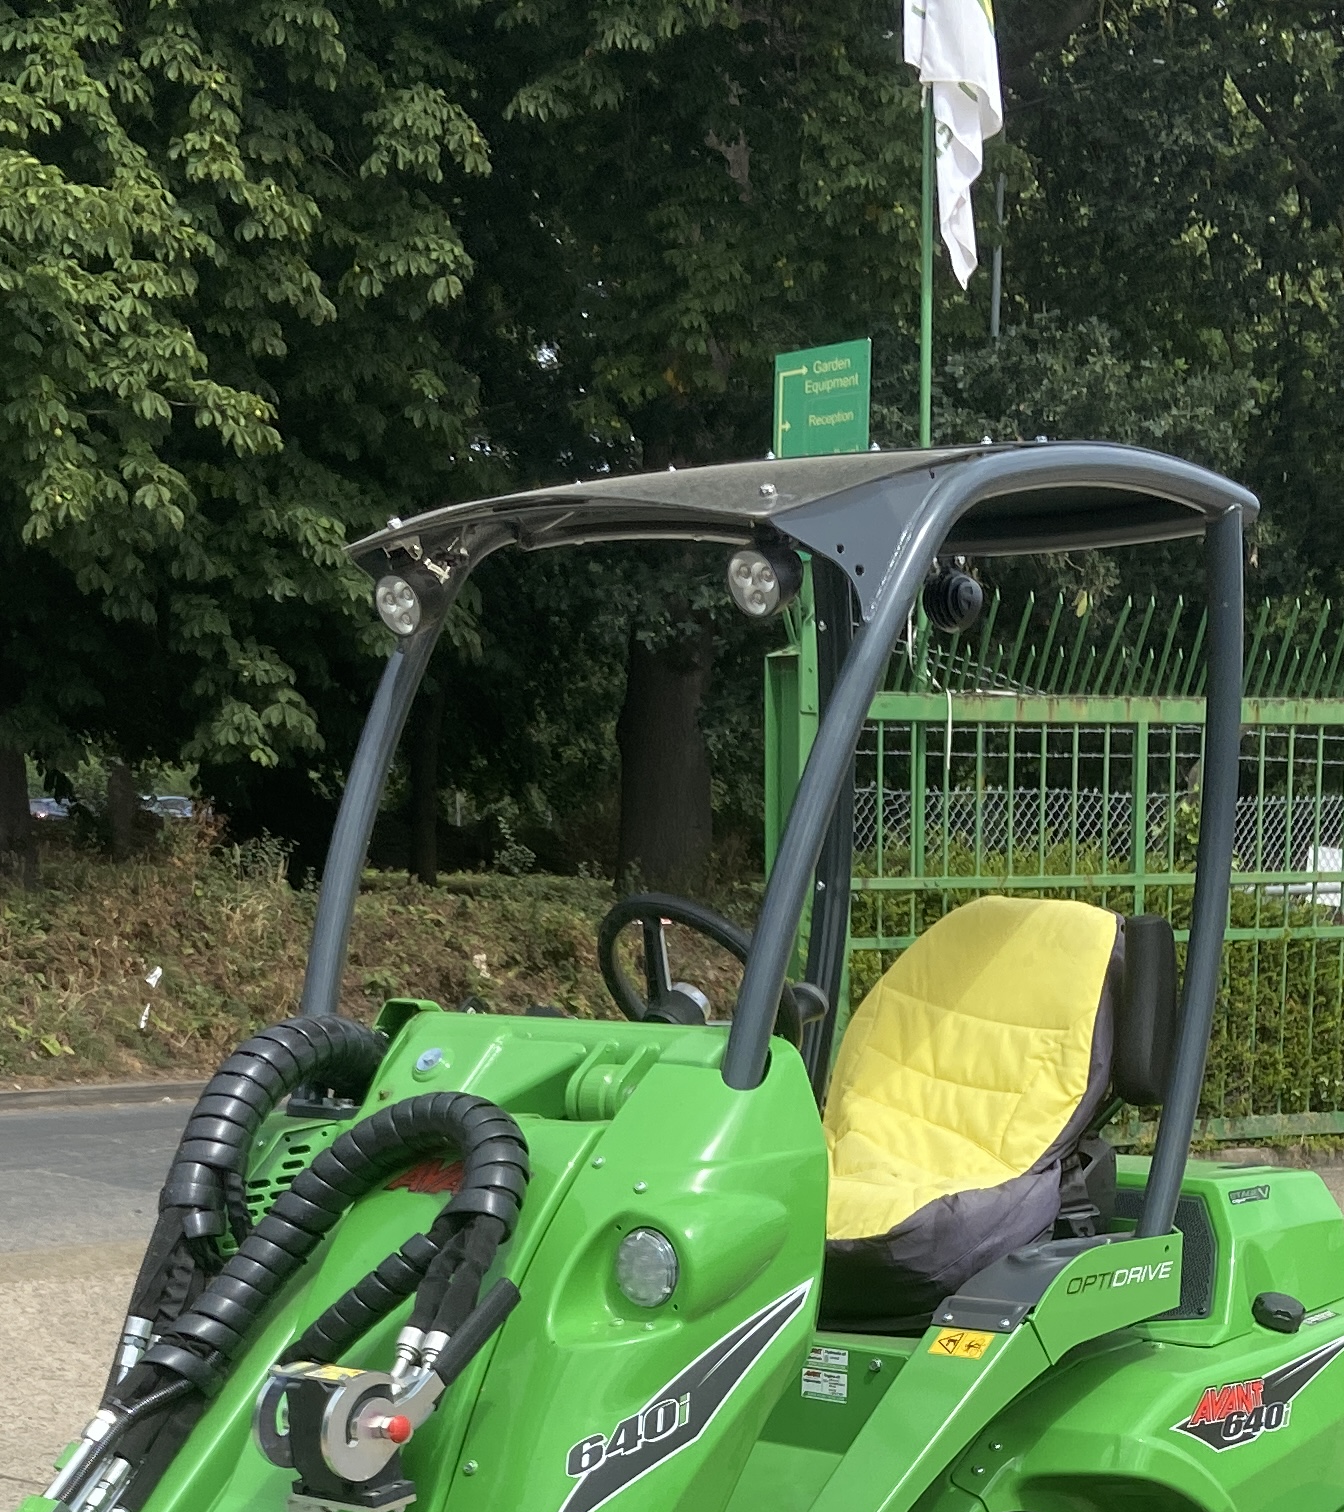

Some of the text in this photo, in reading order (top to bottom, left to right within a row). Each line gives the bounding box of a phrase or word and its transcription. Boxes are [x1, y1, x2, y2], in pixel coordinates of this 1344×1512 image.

[813, 357, 851, 374] Garden
[805, 372, 859, 395] Equipment
[808, 410, 854, 427] Reception
[1066, 1260, 1174, 1295] OPTIDRIVE
[1186, 1377, 1265, 1428] AVANT
[565, 1392, 691, 1479] 640i
[1221, 1401, 1293, 1441] 640i
